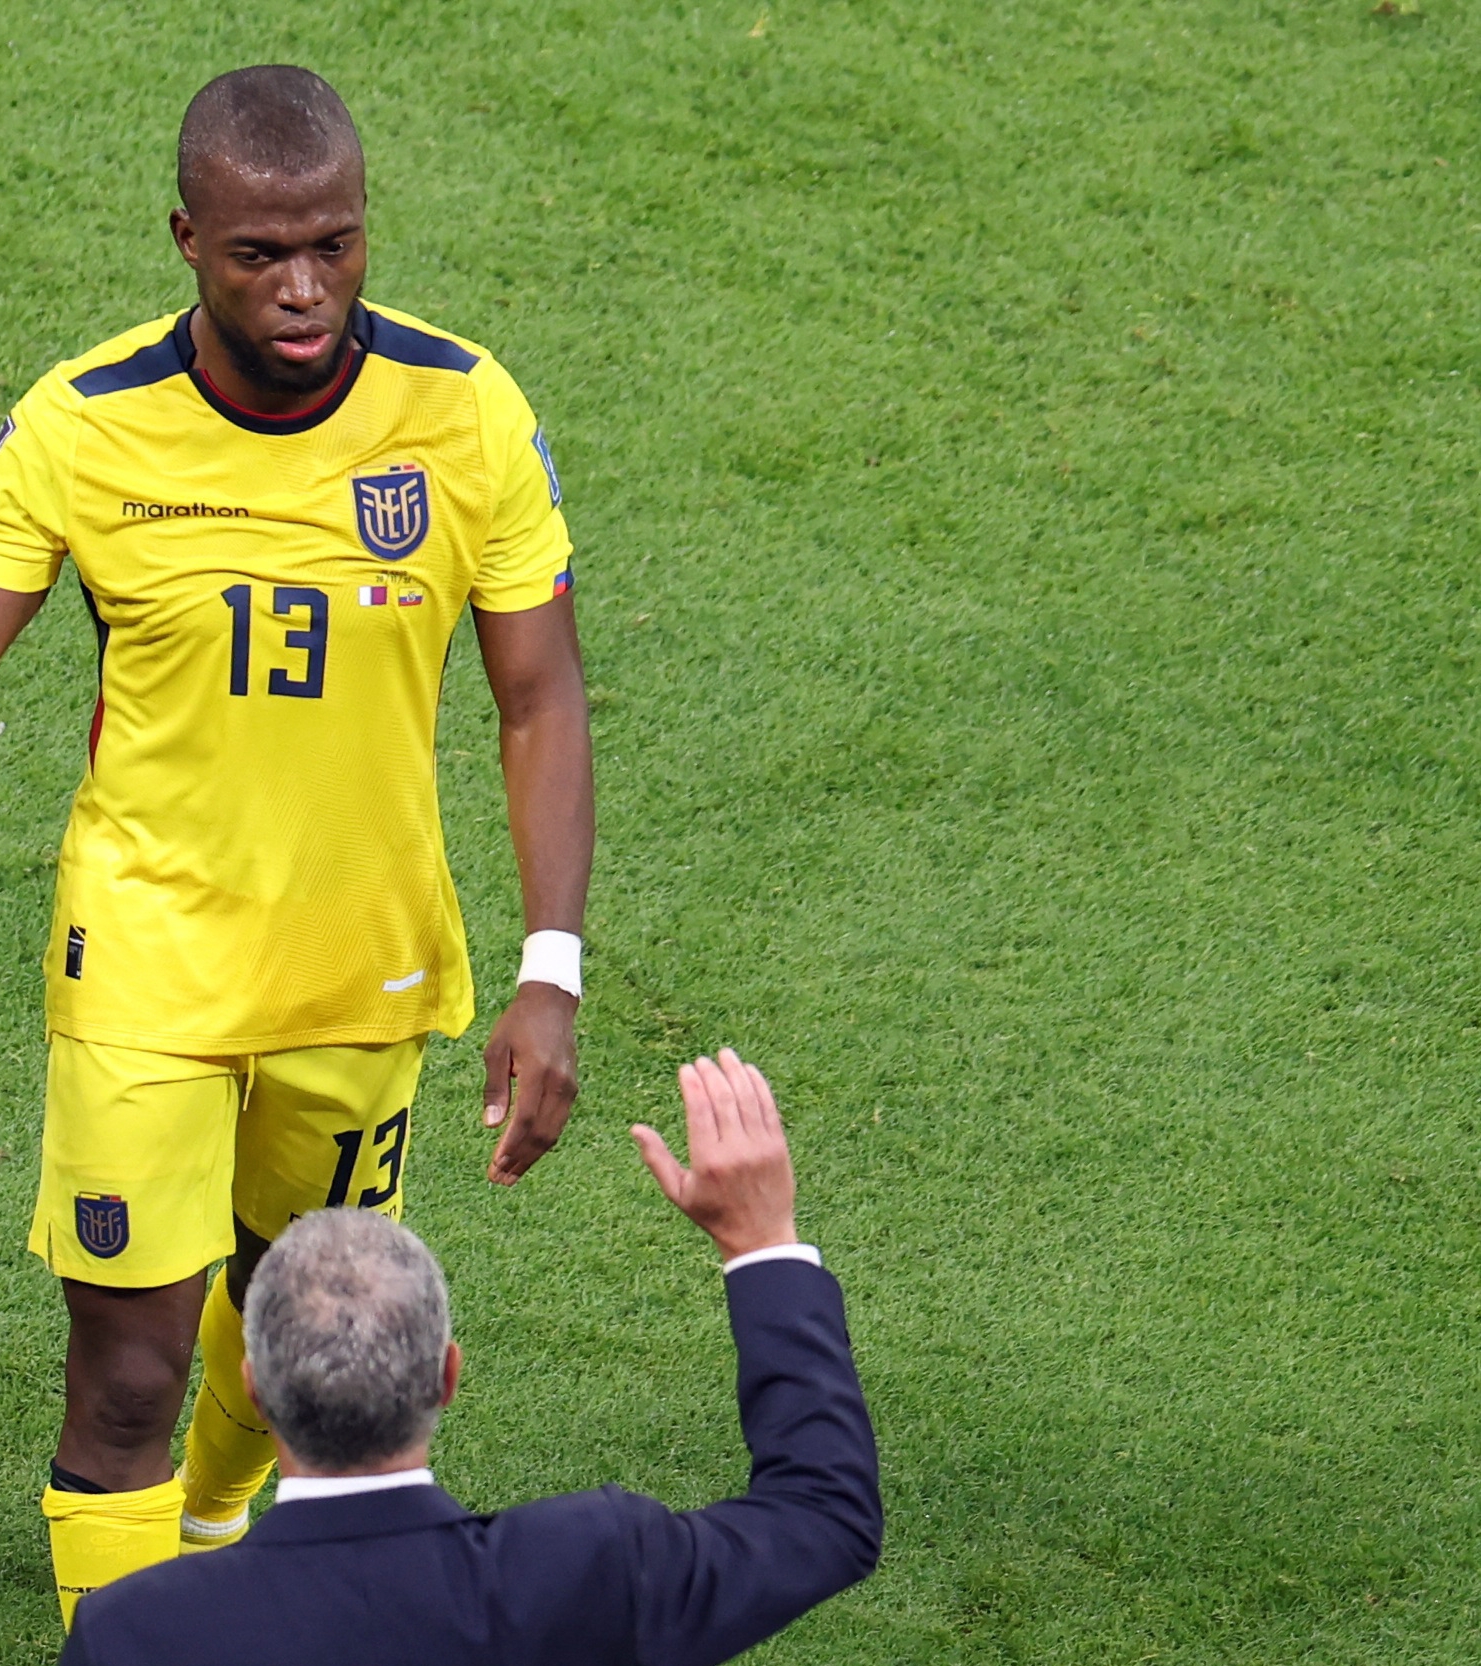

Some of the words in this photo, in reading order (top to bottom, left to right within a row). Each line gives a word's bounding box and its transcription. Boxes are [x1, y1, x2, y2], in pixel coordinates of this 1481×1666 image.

[122, 501, 250, 518] marathon
[220, 583, 329, 699] 13
[324, 1107, 409, 1209] 13
